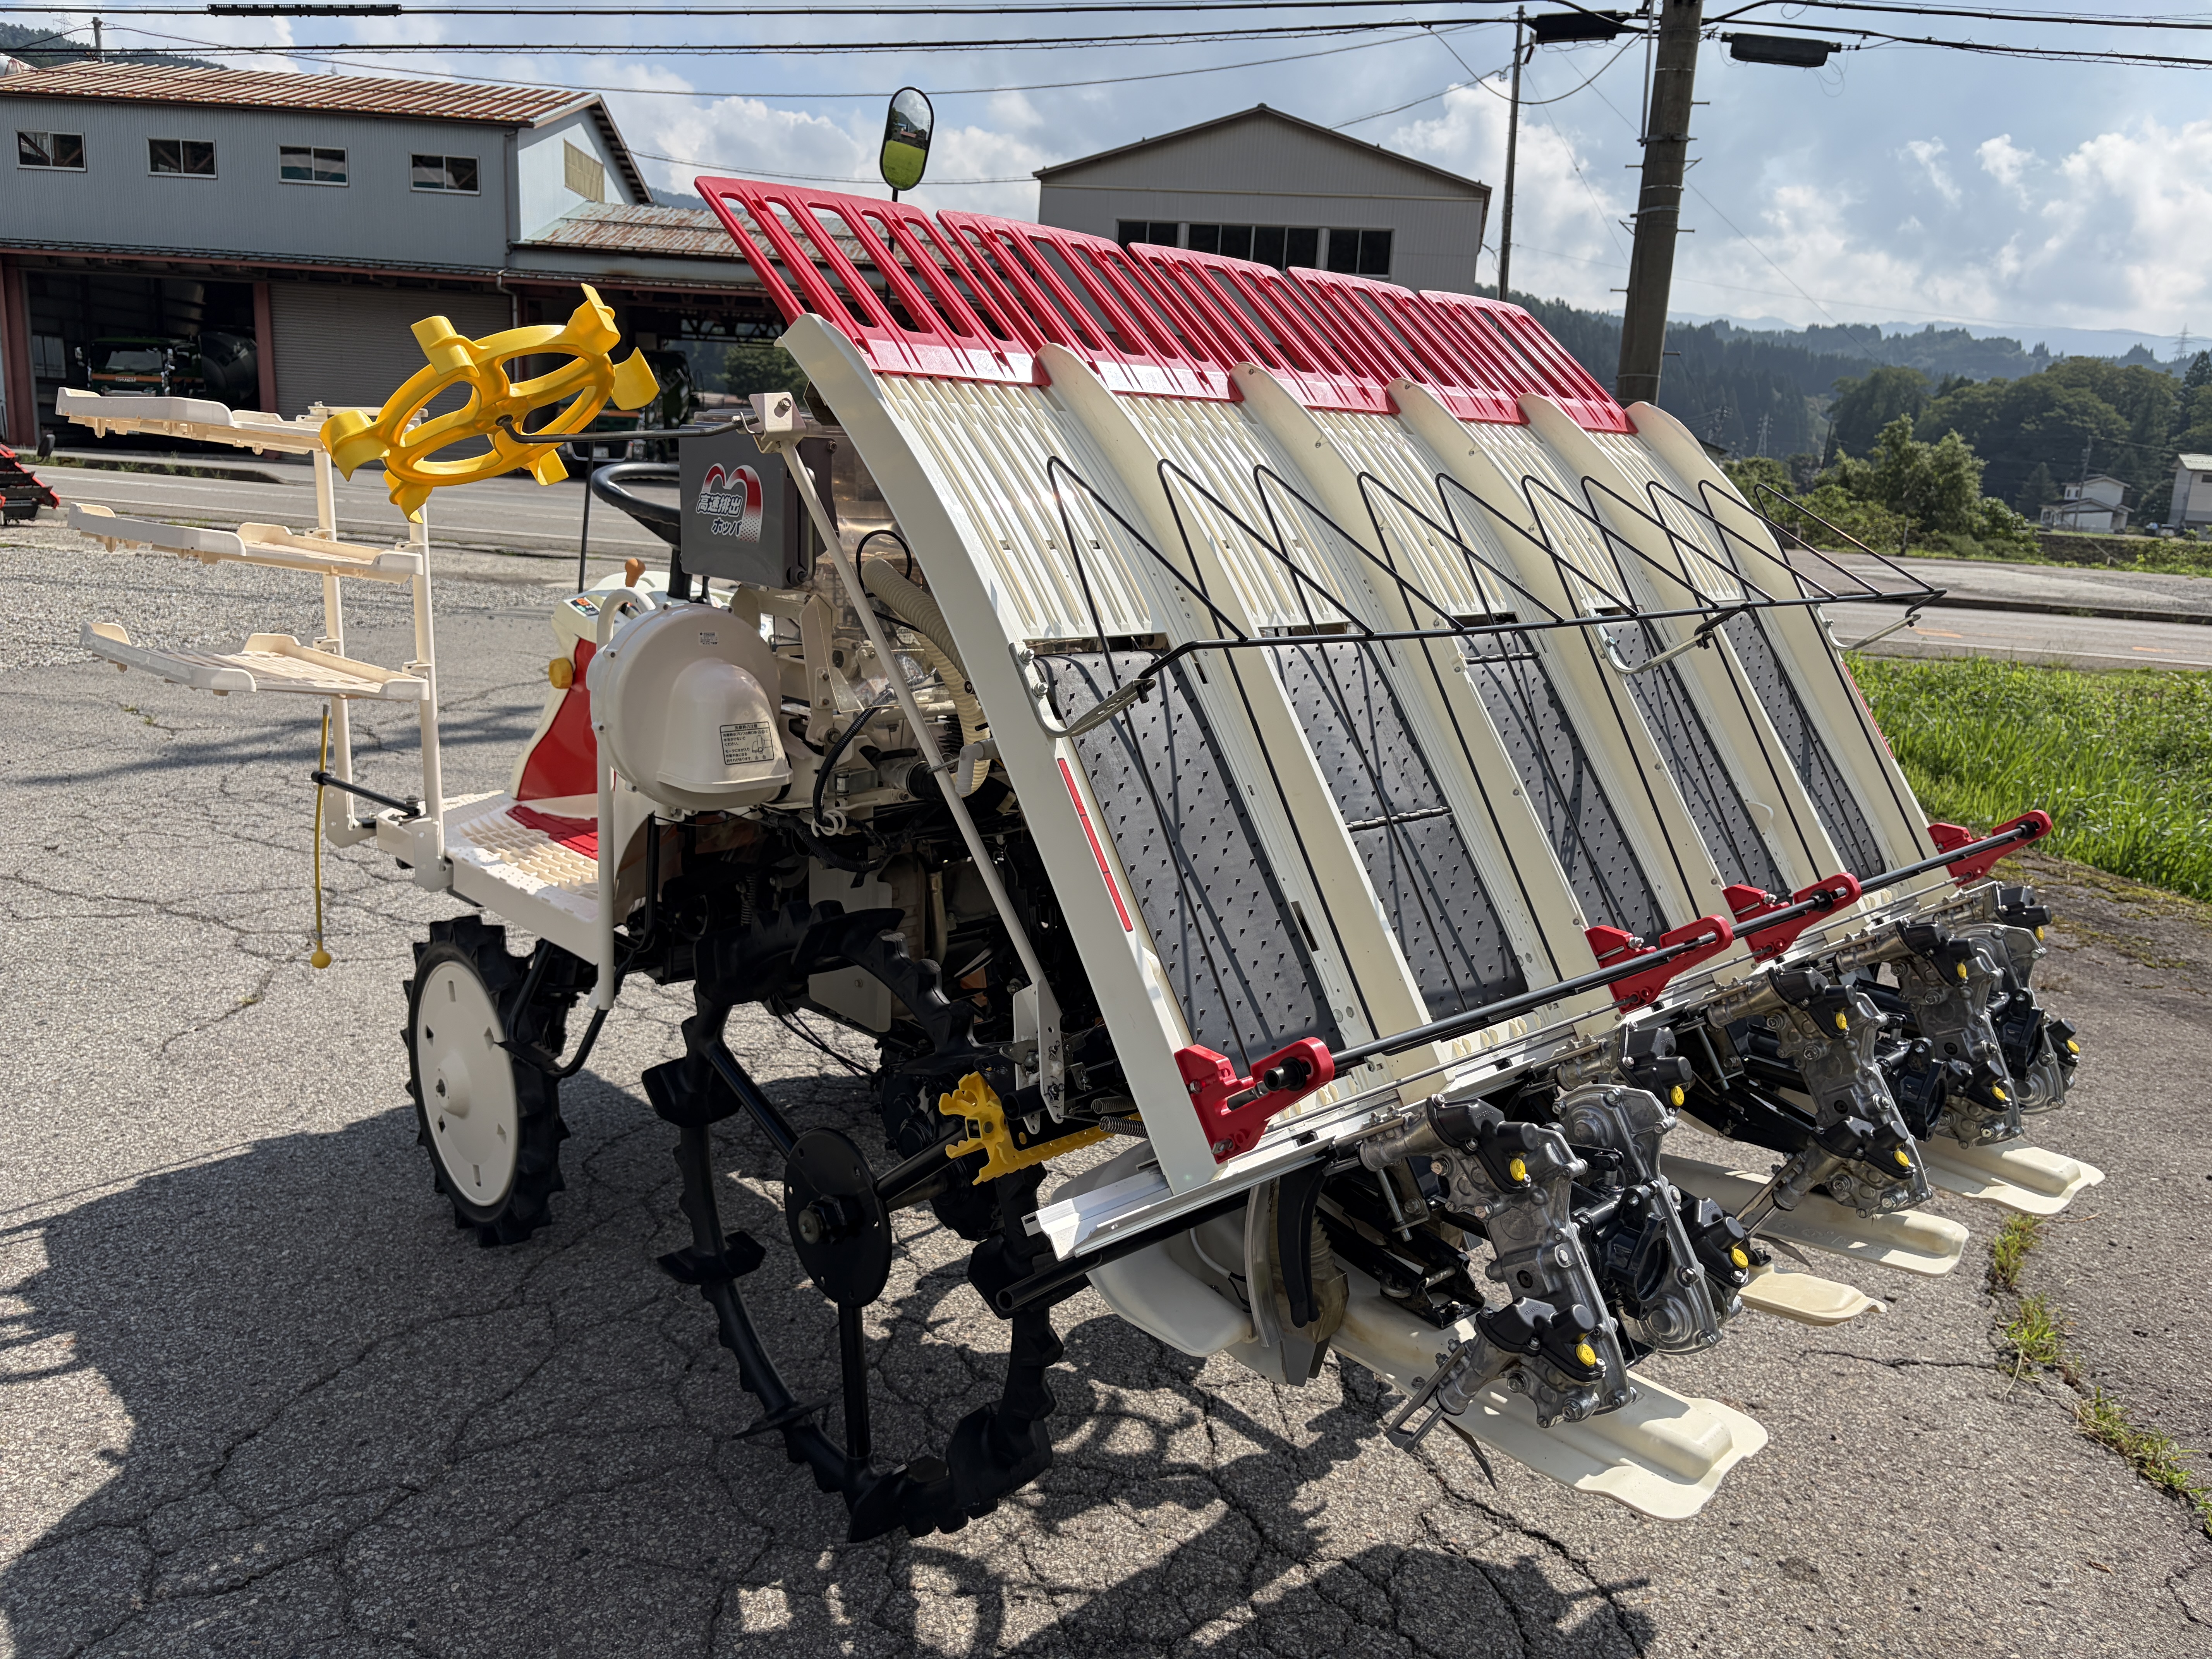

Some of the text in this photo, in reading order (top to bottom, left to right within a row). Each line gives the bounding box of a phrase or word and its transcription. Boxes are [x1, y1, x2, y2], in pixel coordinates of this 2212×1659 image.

[697, 493, 743, 517] 高速排出
[712, 518, 742, 536] ホッパ
